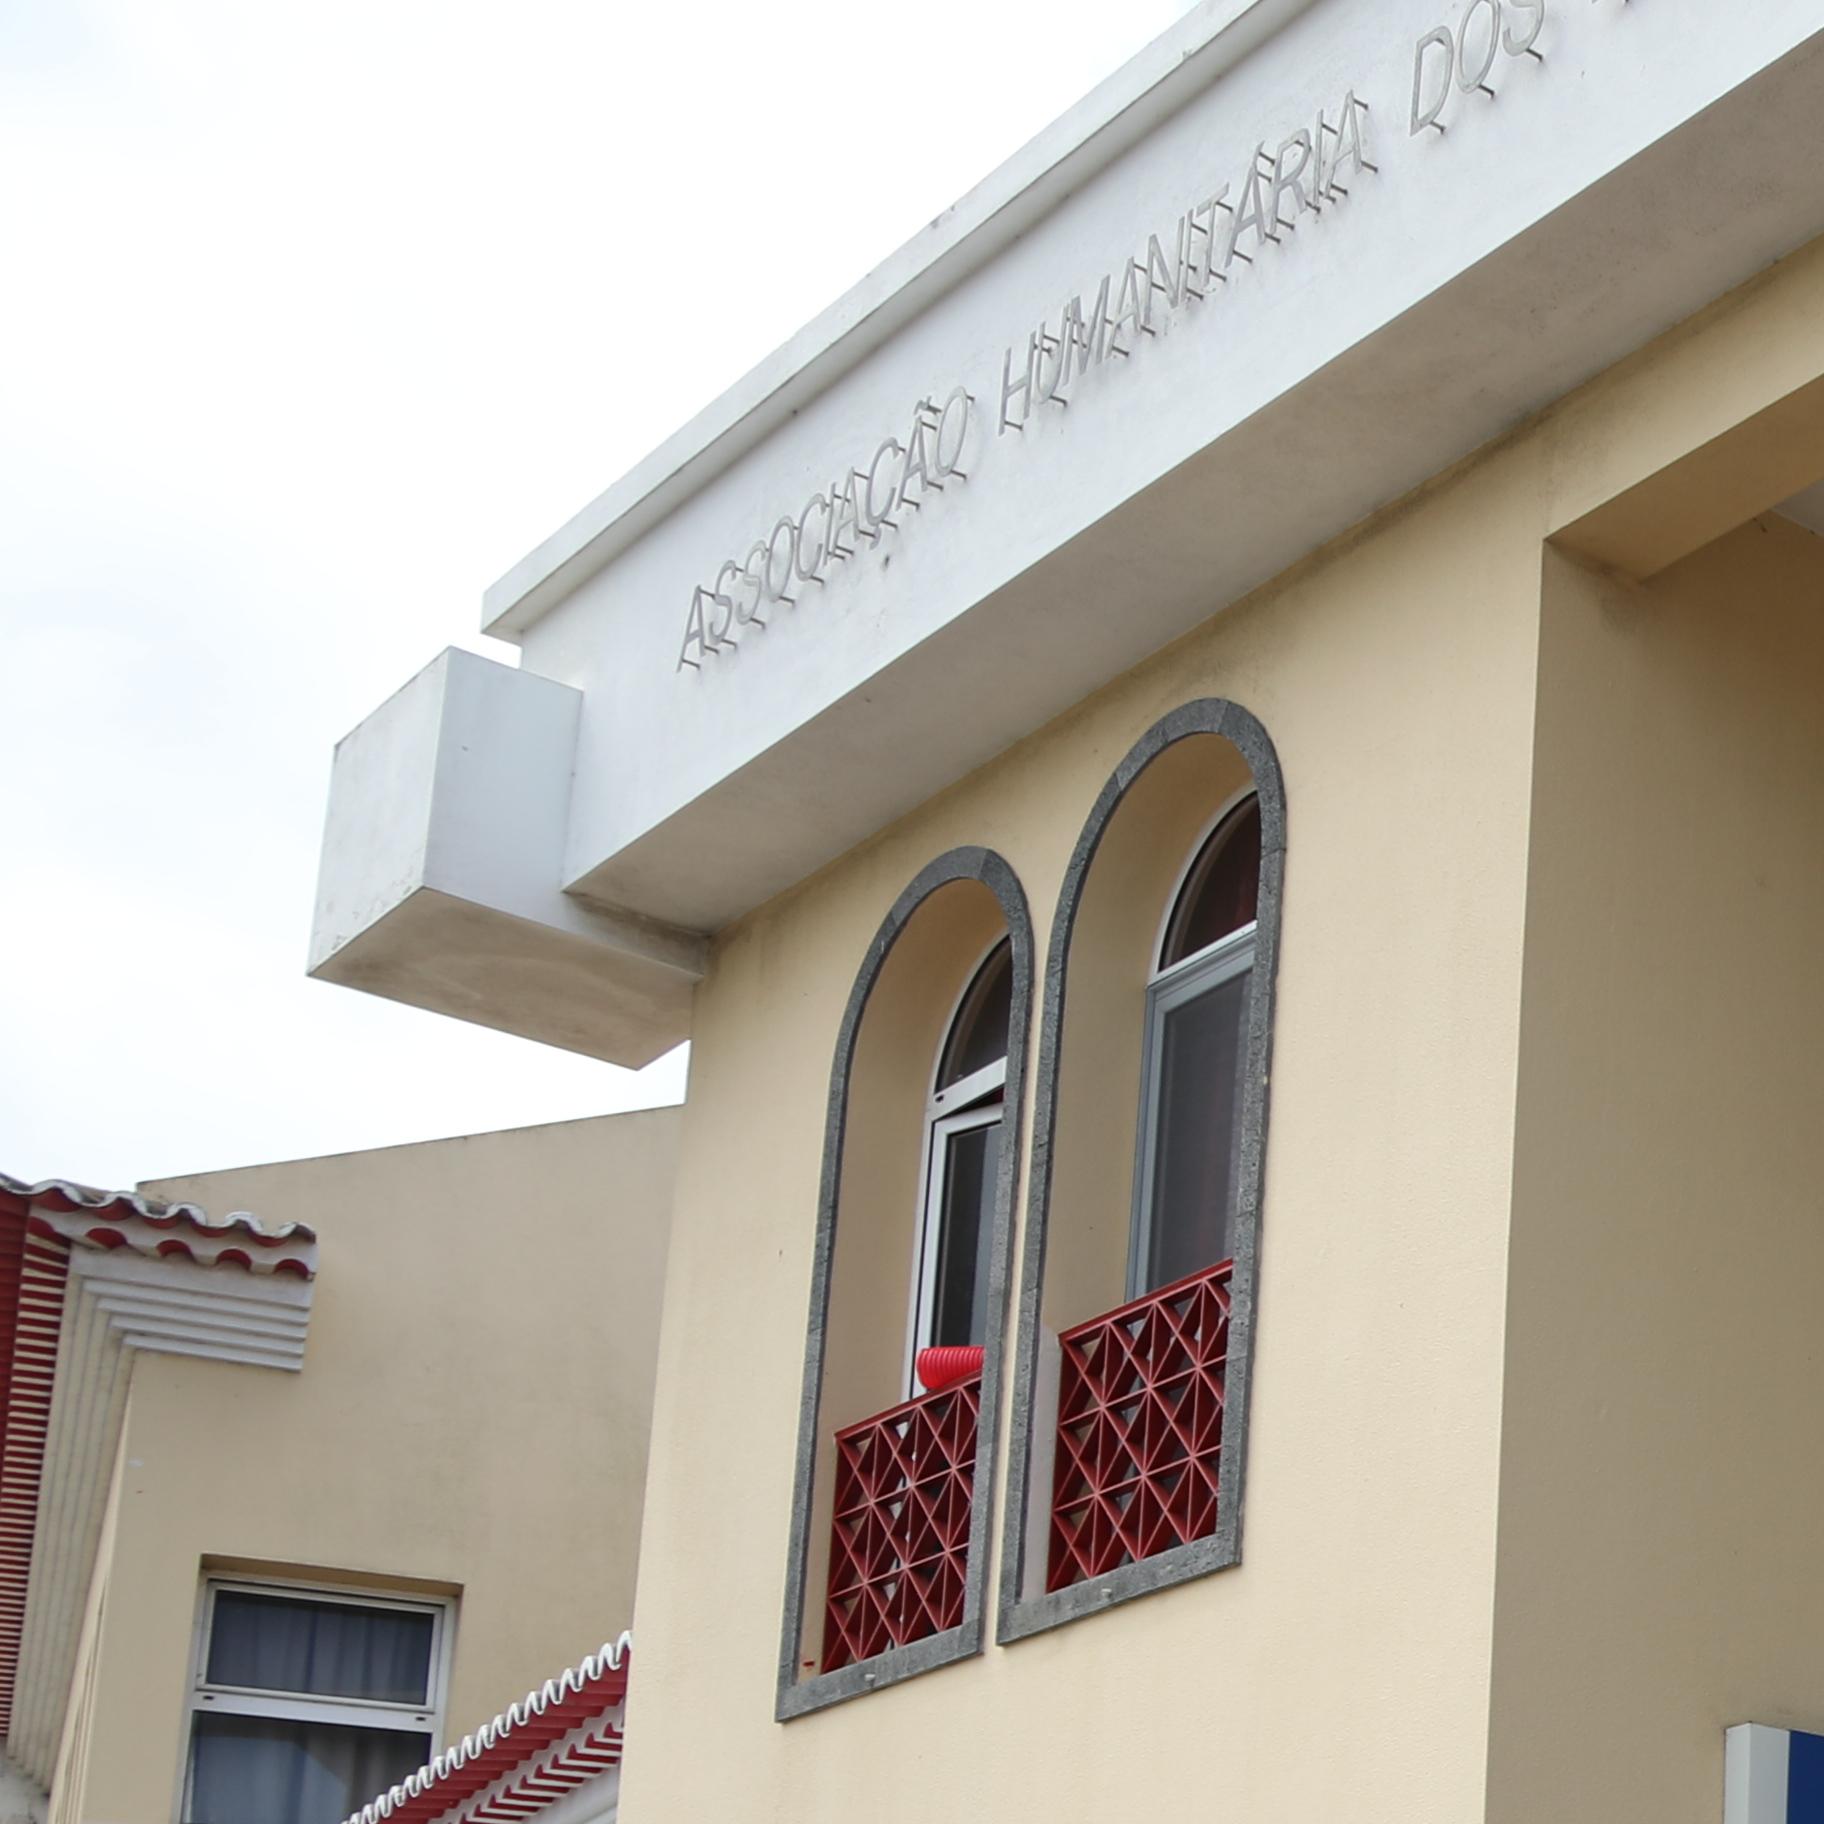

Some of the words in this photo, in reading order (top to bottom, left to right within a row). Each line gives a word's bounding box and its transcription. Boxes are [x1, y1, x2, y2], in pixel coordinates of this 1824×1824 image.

[676, 386, 971, 673] ASSOCIAÇÃO
[997, 90, 1365, 436] HUMANITÁRIA
[1410, 0, 1544, 136] DOS
